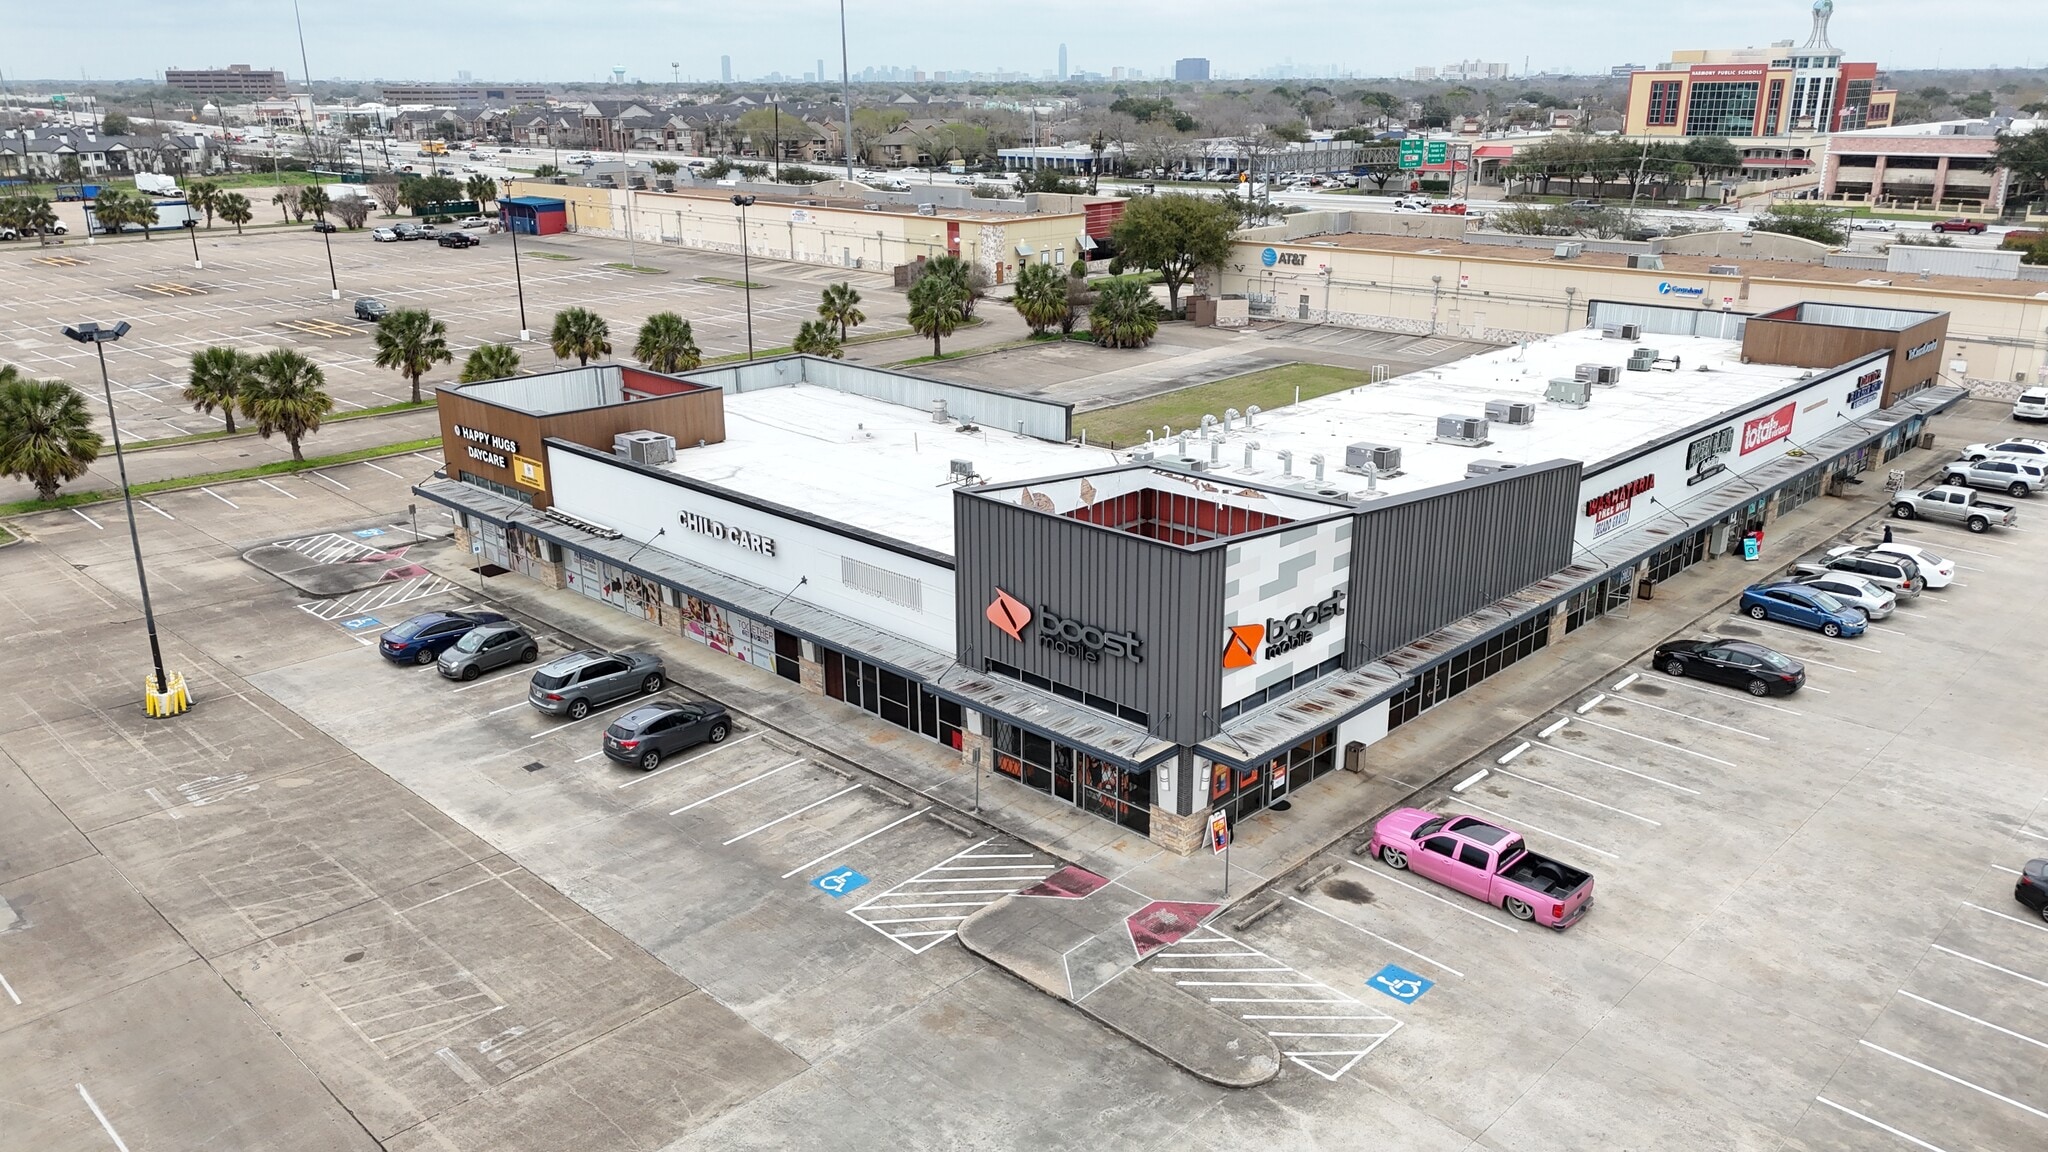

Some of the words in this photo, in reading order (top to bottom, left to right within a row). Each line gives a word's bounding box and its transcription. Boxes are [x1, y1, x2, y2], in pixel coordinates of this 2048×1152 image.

[1278, 253, 1307, 266] AT&T
[462, 427, 490, 445] HAPPY
[492, 436, 516, 453] HUGS
[1745, 415, 1775, 450] total
[467, 445, 506, 468] DAYCARE
[1586, 474, 1654, 517] WASHATERIA
[678, 510, 725, 540] CHILD
[728, 527, 775, 557] CARE
[1265, 590, 1346, 645] boost
[1039, 605, 1142, 663] boost
[1040, 635, 1098, 663] mobile
[1265, 630, 1314, 660] mobile
